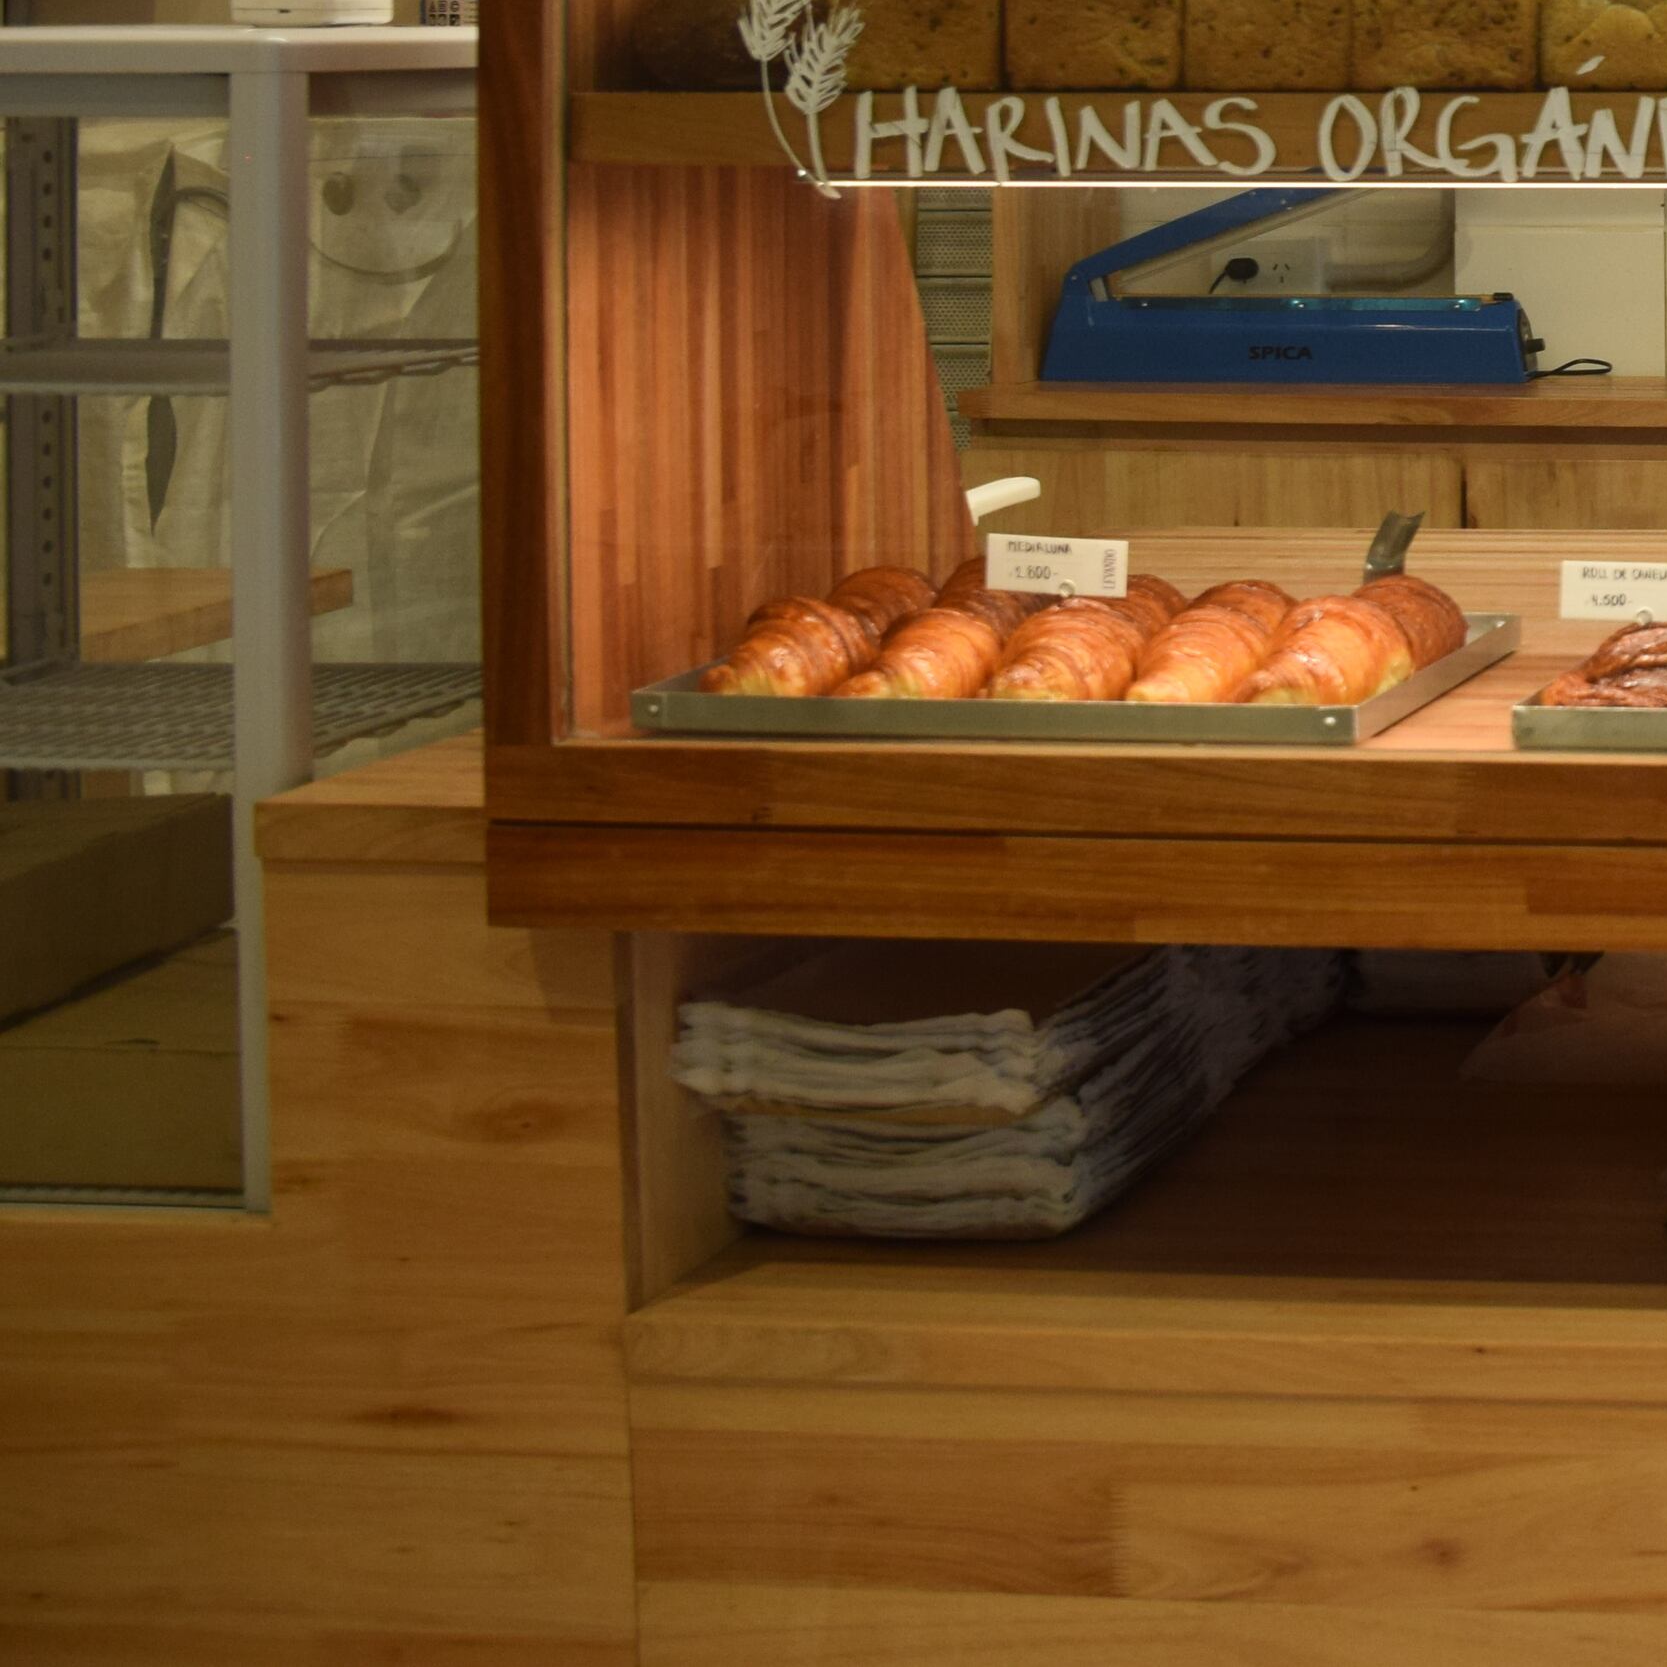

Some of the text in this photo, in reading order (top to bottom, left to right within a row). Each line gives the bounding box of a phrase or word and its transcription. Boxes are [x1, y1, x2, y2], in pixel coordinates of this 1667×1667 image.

[853, 84, 1278, 182] HARINAS
[1248, 345, 1313, 361] SPICA
[1103, 548, 1118, 590] LEVANDO
[1582, 566, 1608, 579] ROLL
